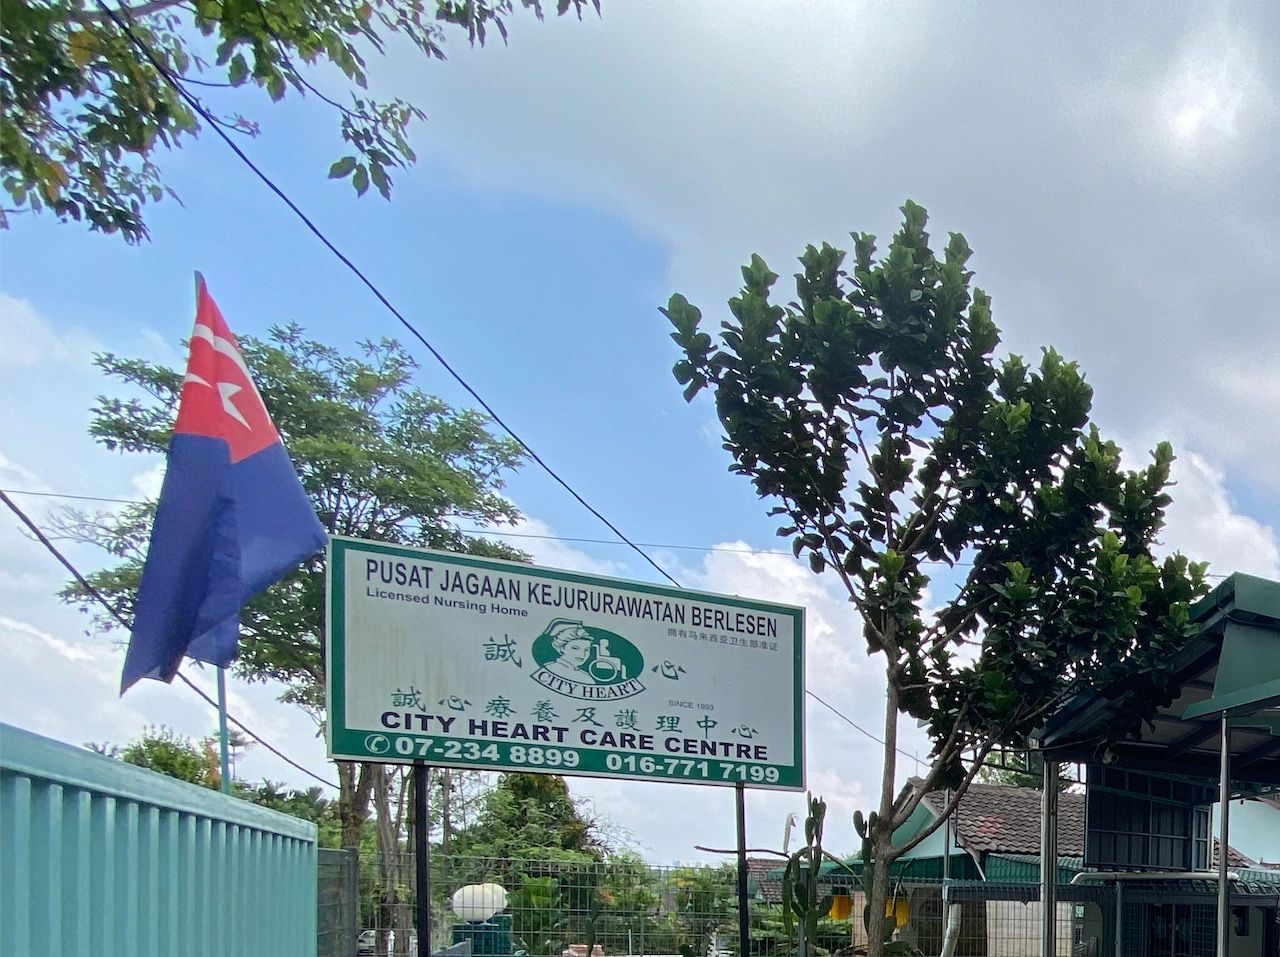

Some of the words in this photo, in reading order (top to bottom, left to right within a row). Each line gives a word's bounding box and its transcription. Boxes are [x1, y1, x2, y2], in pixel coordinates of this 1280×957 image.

[366, 558, 434, 589] PUSAT
[440, 569, 521, 602] JAGAAN
[528, 581, 685, 624] KEJURURAWATAN
[691, 606, 777, 638] BERLESEN
[366, 586, 430, 604] Licensed
[434, 595, 487, 614] Nursing
[491, 603, 529, 617] Home
[482, 633, 523, 668] 誠
[651, 660, 687, 681] 心
[538, 670, 578, 694] CITY
[583, 679, 639, 699] HEART
[668, 699, 694, 709] SINCE
[696, 701, 715, 711] 1993
[381, 711, 456, 733] CITY
[468, 718, 569, 743] HEART
[580, 729, 654, 750] CARE
[664, 736, 768, 761] CENTRE
[395, 736, 501, 762] 07-234
[509, 745, 580, 768] 8899
[606, 753, 709, 778] 016-771
[719, 763, 780, 783] 7199
